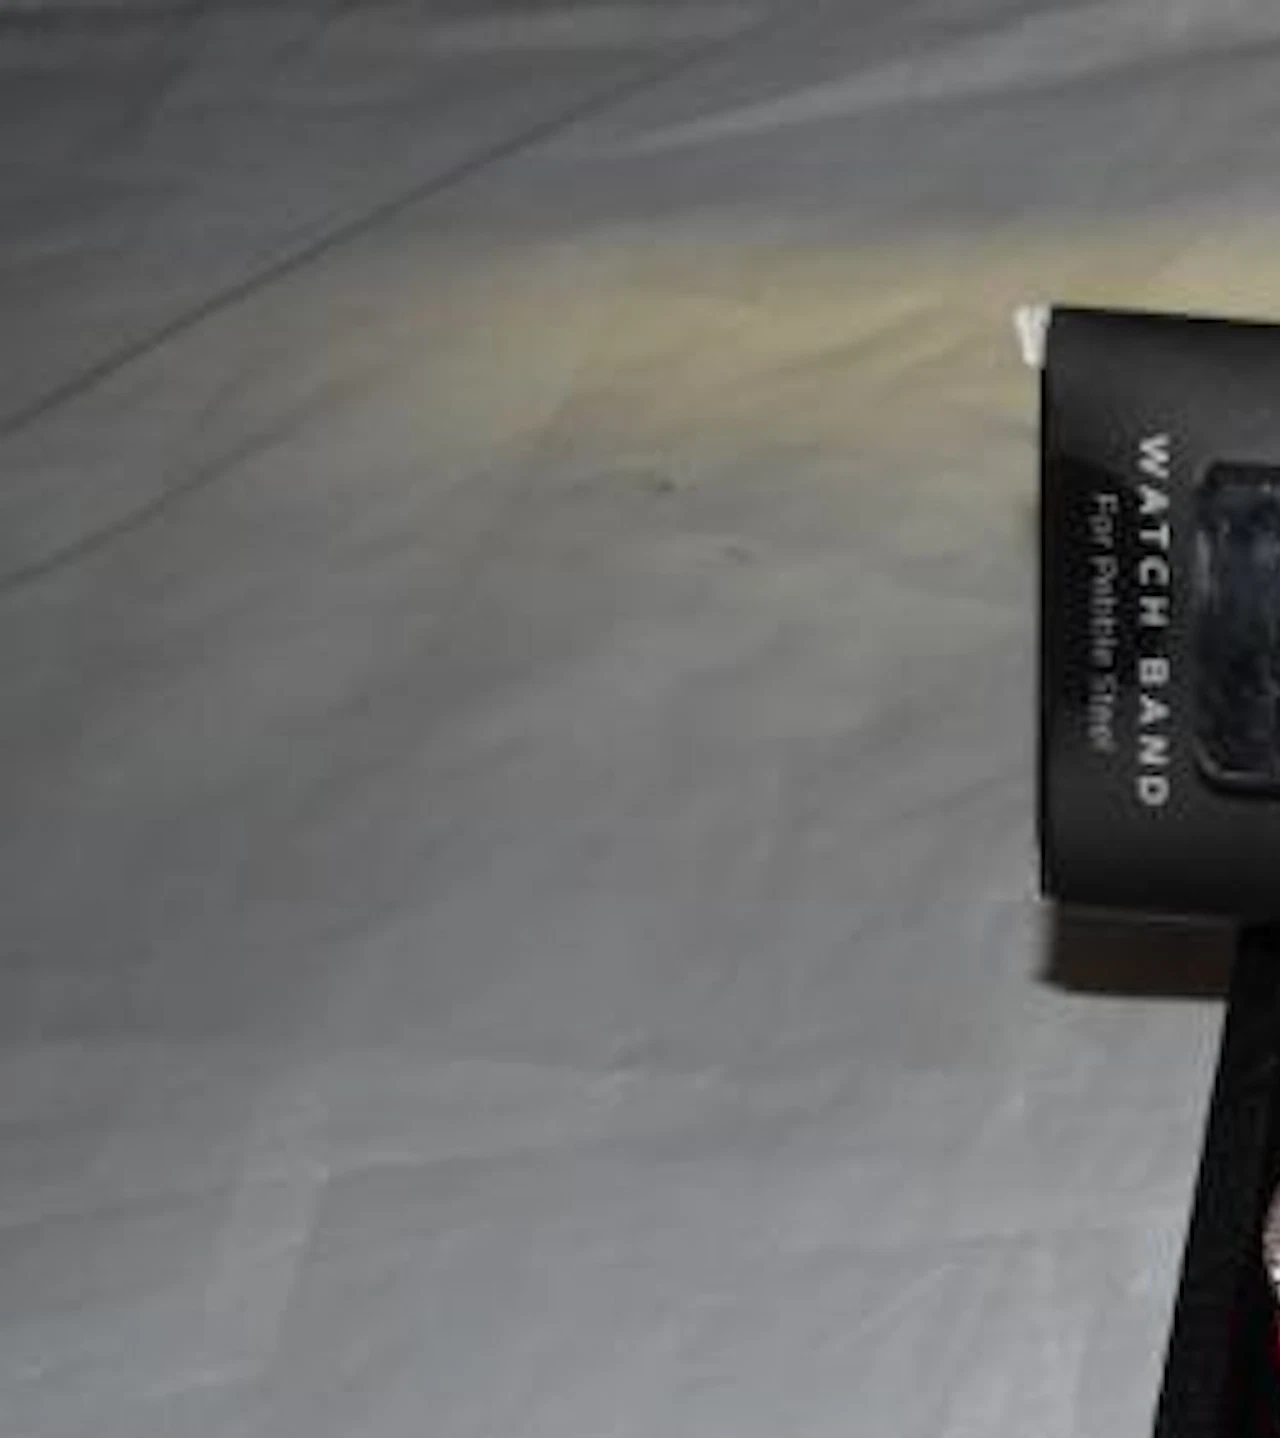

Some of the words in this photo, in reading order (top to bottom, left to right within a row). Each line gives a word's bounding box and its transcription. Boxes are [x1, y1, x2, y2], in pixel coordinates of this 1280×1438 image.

[1088, 492, 1119, 549] For
[1137, 432, 1171, 627] WATCH
[1137, 656, 1171, 806] BAND
